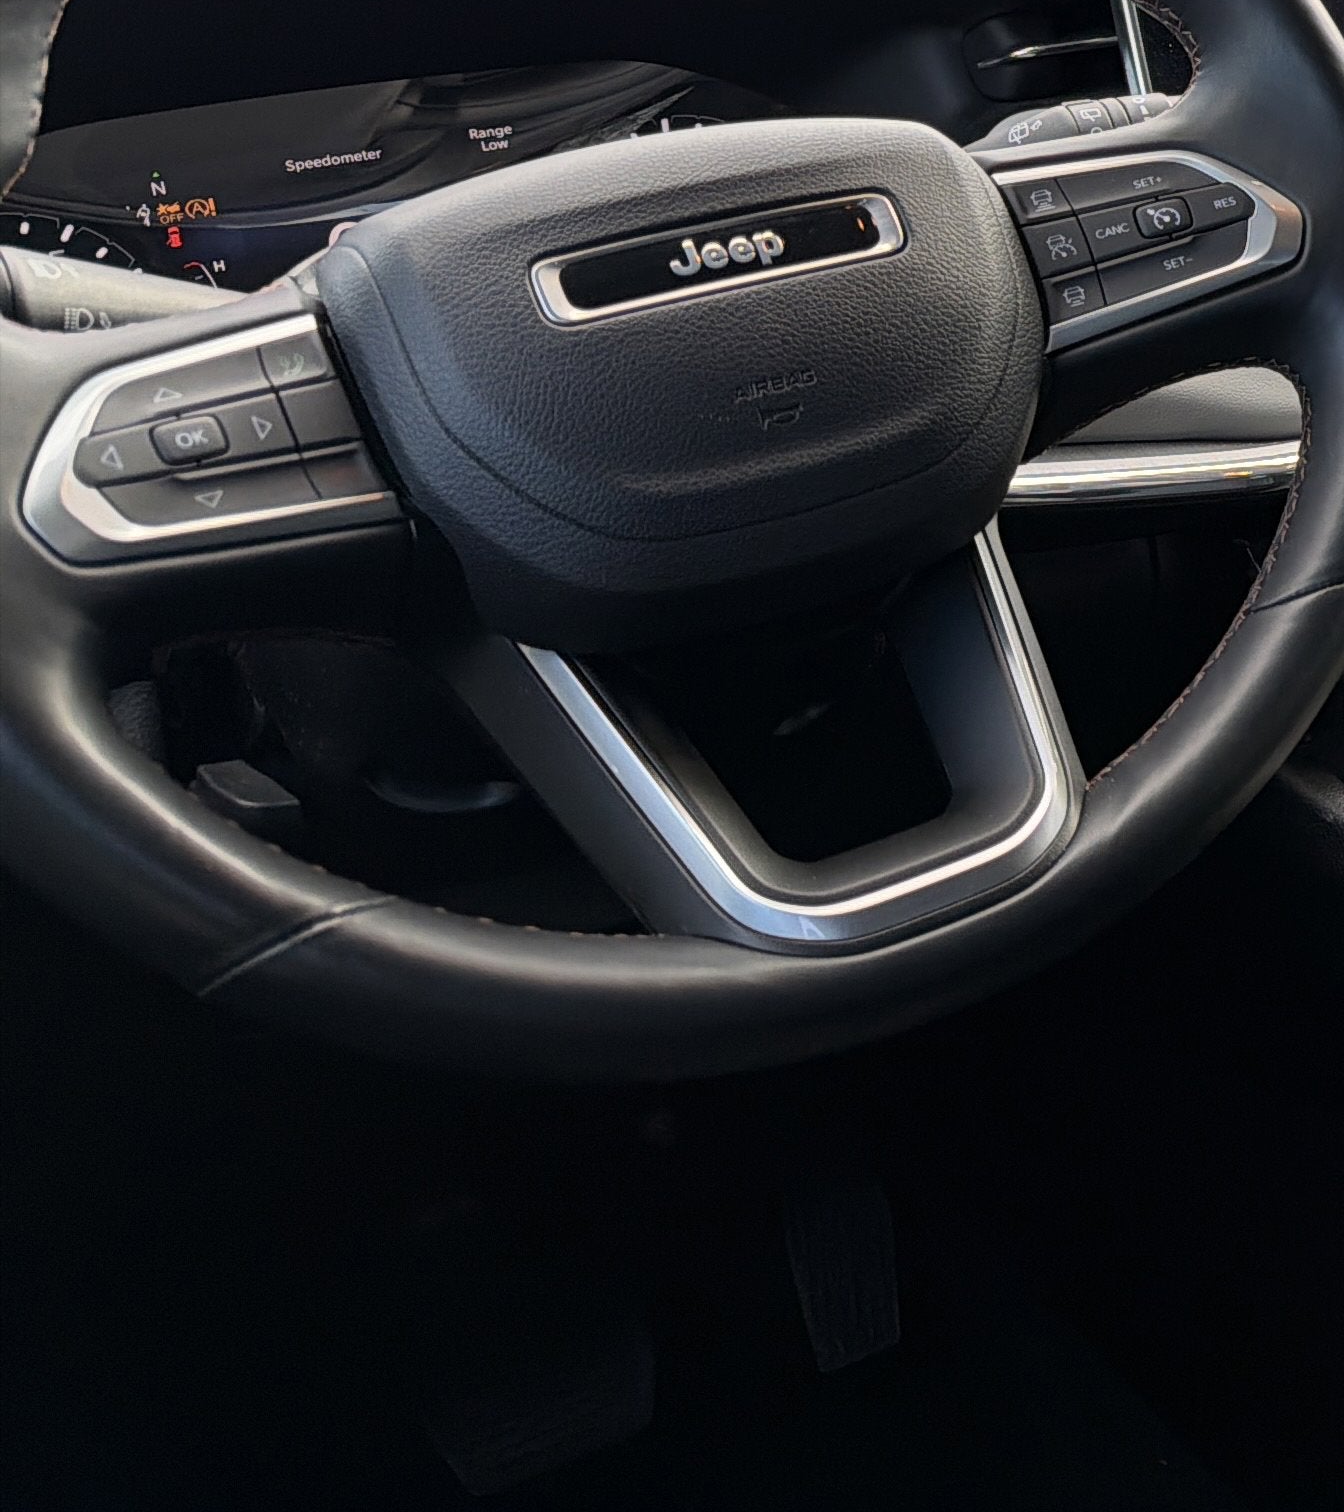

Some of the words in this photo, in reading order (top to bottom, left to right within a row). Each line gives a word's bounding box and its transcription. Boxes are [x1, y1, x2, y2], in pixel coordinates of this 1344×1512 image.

[468, 123, 513, 141] Range
[480, 137, 509, 153] Low
[284, 147, 383, 173] Speedometer
[150, 181, 168, 197] N
[1132, 174, 1163, 190] SET+
[1212, 195, 1238, 211] RES
[159, 210, 185, 224] OFF
[1094, 222, 1131, 240] CANC
[669, 229, 786, 277] Jeep
[213, 260, 227, 273] H
[174, 427, 209, 448] OK
